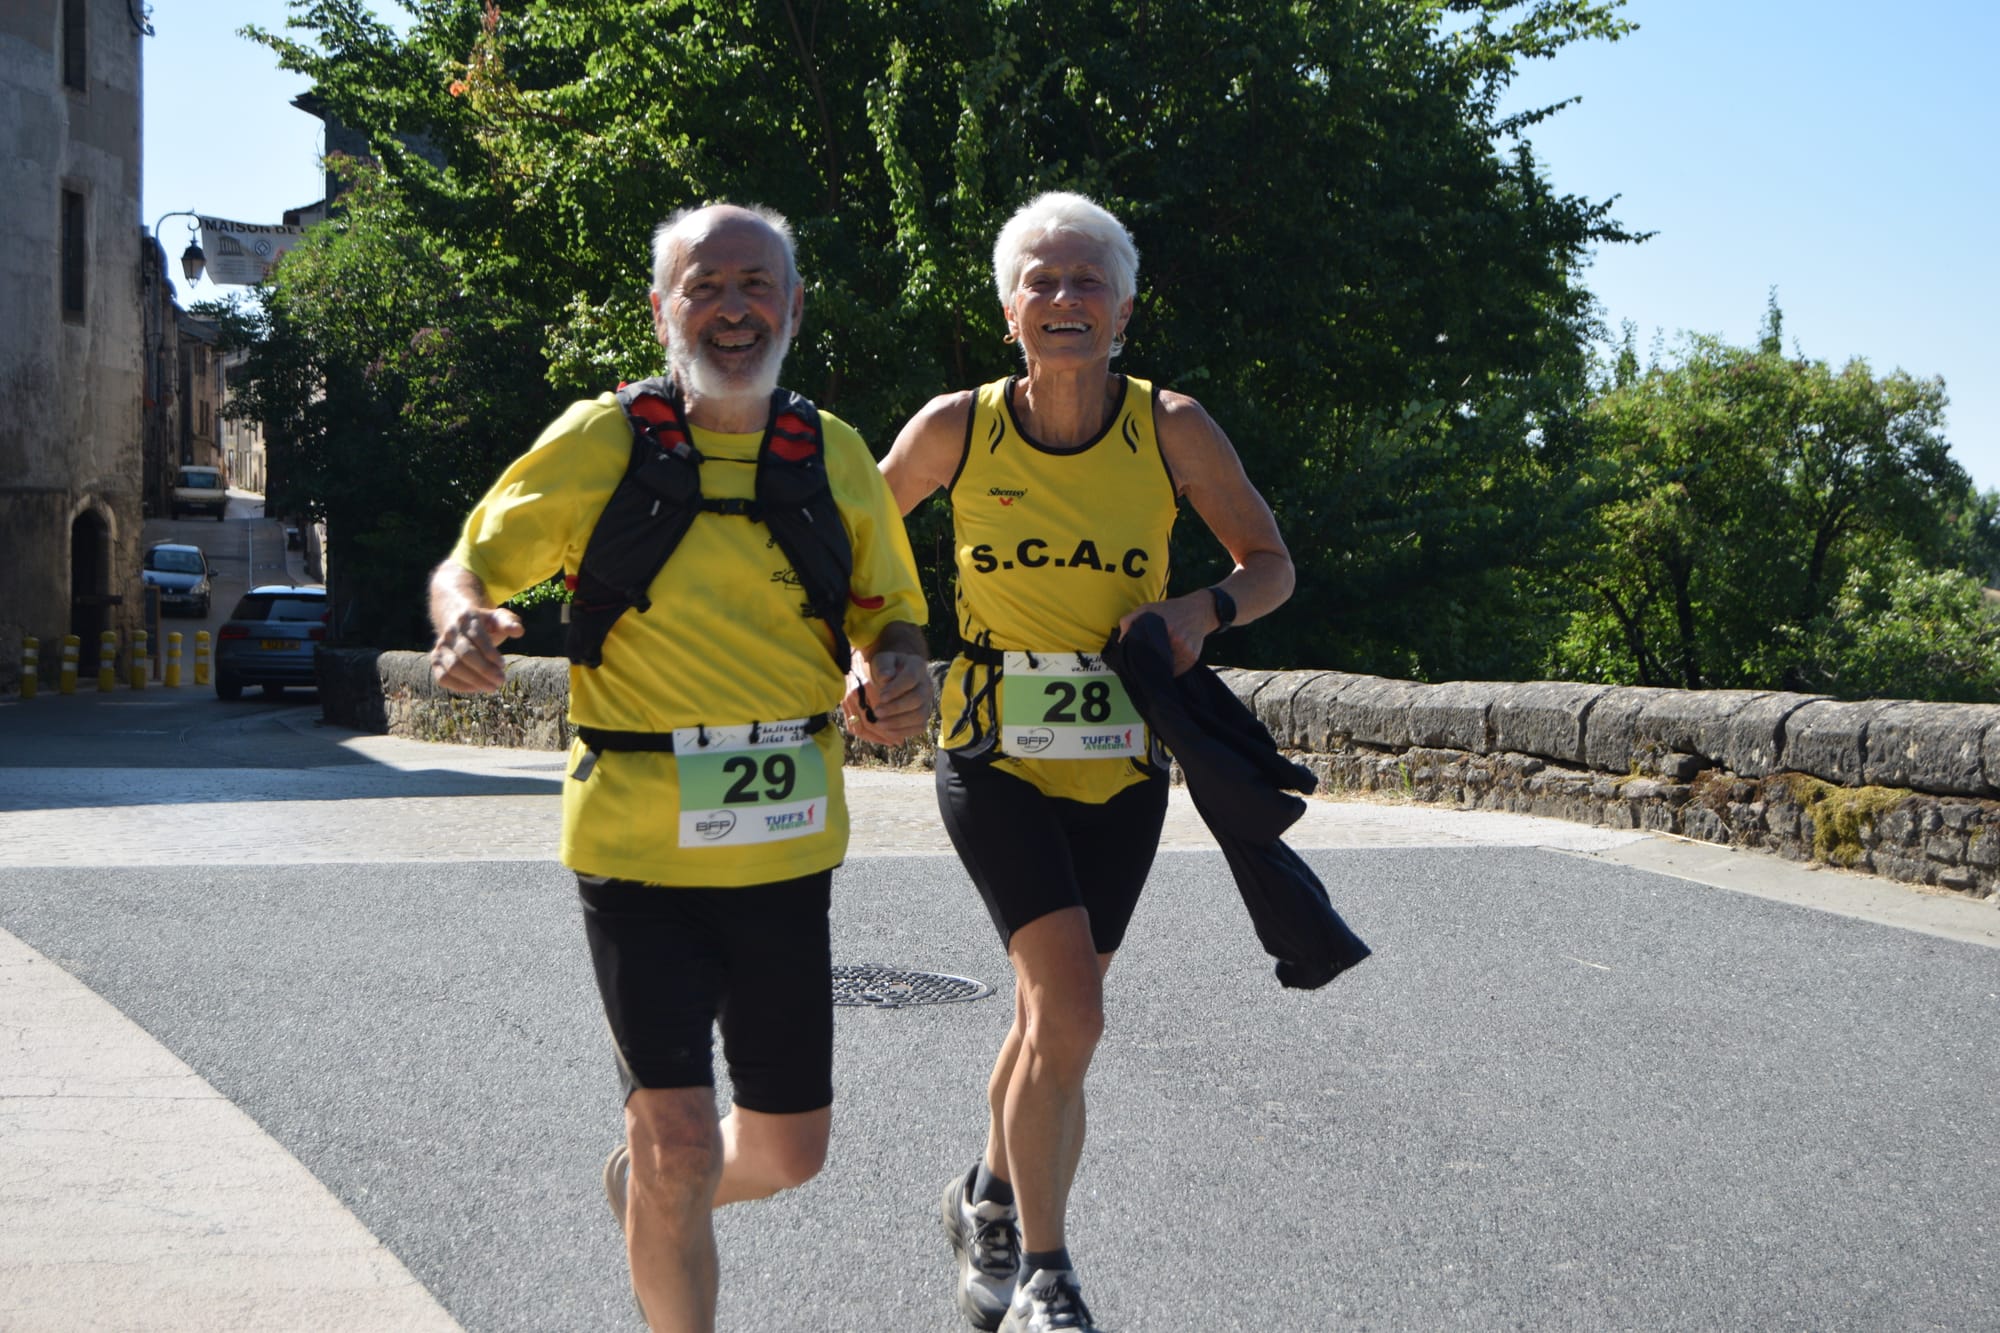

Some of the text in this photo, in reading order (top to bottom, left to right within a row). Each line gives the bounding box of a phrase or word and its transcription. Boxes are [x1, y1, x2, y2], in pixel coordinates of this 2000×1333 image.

[204, 219, 271, 234] MAISON
[971, 538, 1149, 579] S.C.A.C
[1042, 681, 1111, 723] 28
[1016, 736, 1050, 745] BFP
[722, 753, 796, 804] 29
[695, 819, 731, 833] BFP
